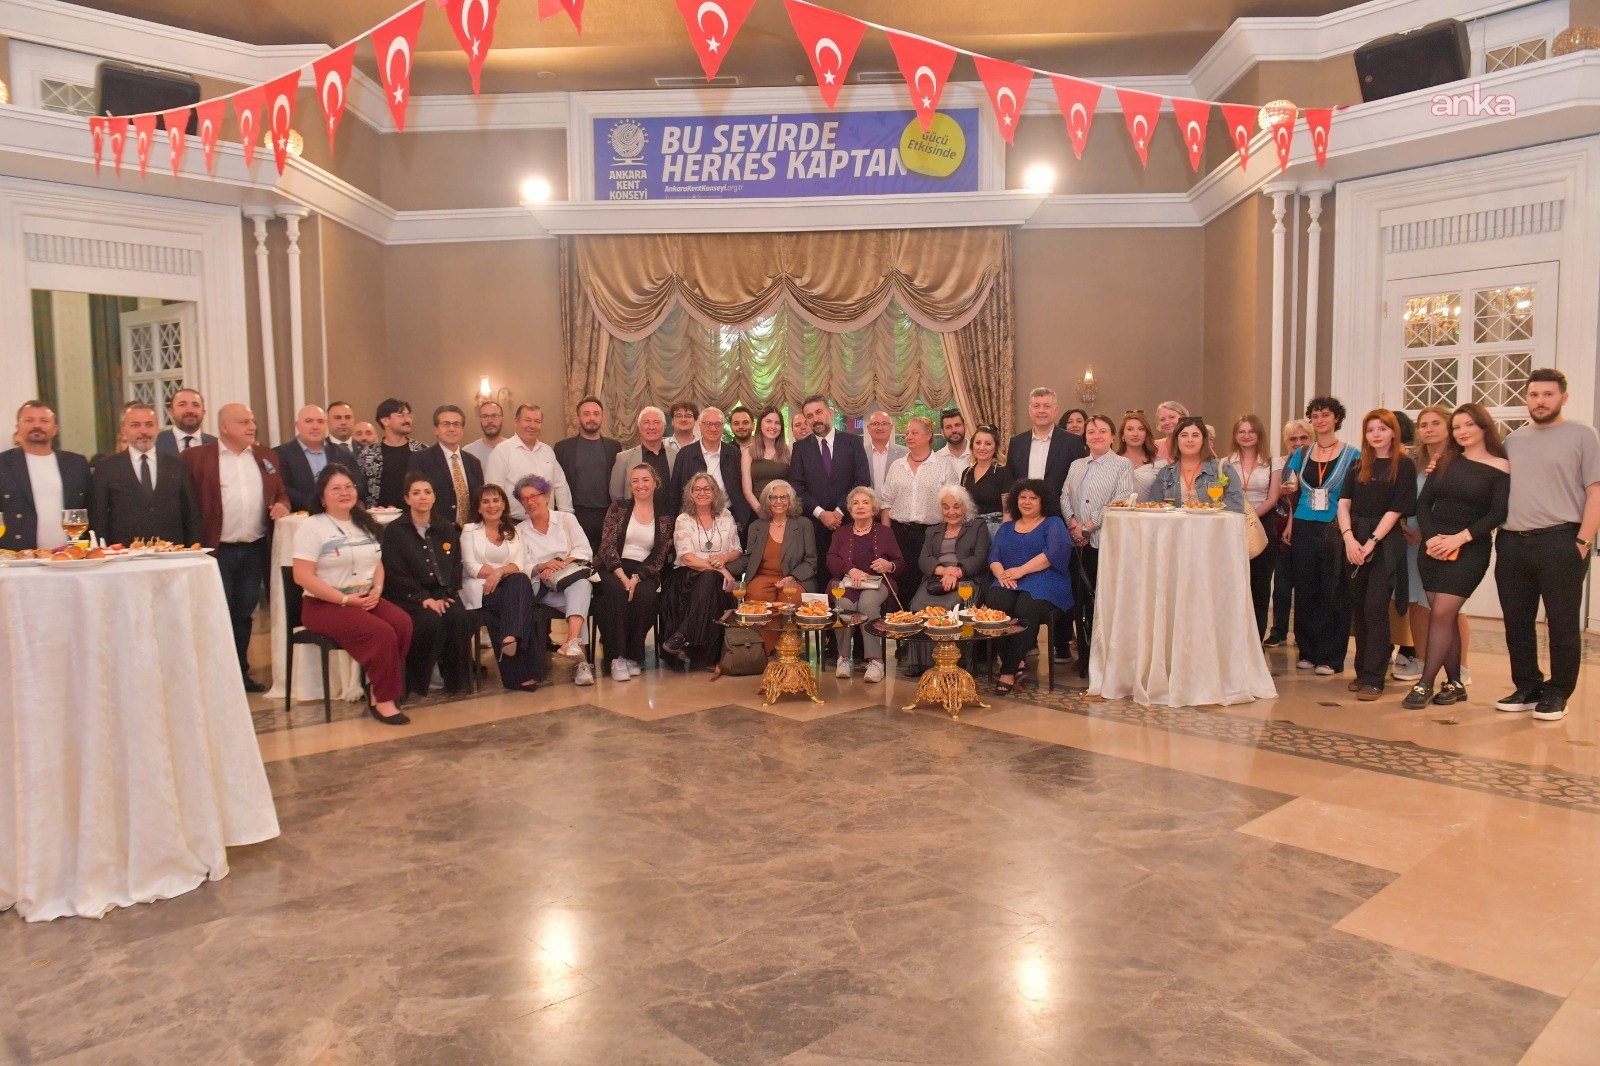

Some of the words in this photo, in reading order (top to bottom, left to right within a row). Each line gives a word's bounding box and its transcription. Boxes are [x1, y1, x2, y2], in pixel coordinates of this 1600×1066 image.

[661, 126, 704, 154] BU
[711, 115, 839, 153] SEYİRDE
[922, 131, 949, 145] Gücü
[907, 139, 957, 160] Etkisinde
[662, 152, 778, 182] HERKES
[786, 148, 908, 179] KAPTAN
[609, 169, 648, 180] ANKARA
[616, 180, 641, 190] KENT
[609, 188, 648, 200] KONSEYİ
